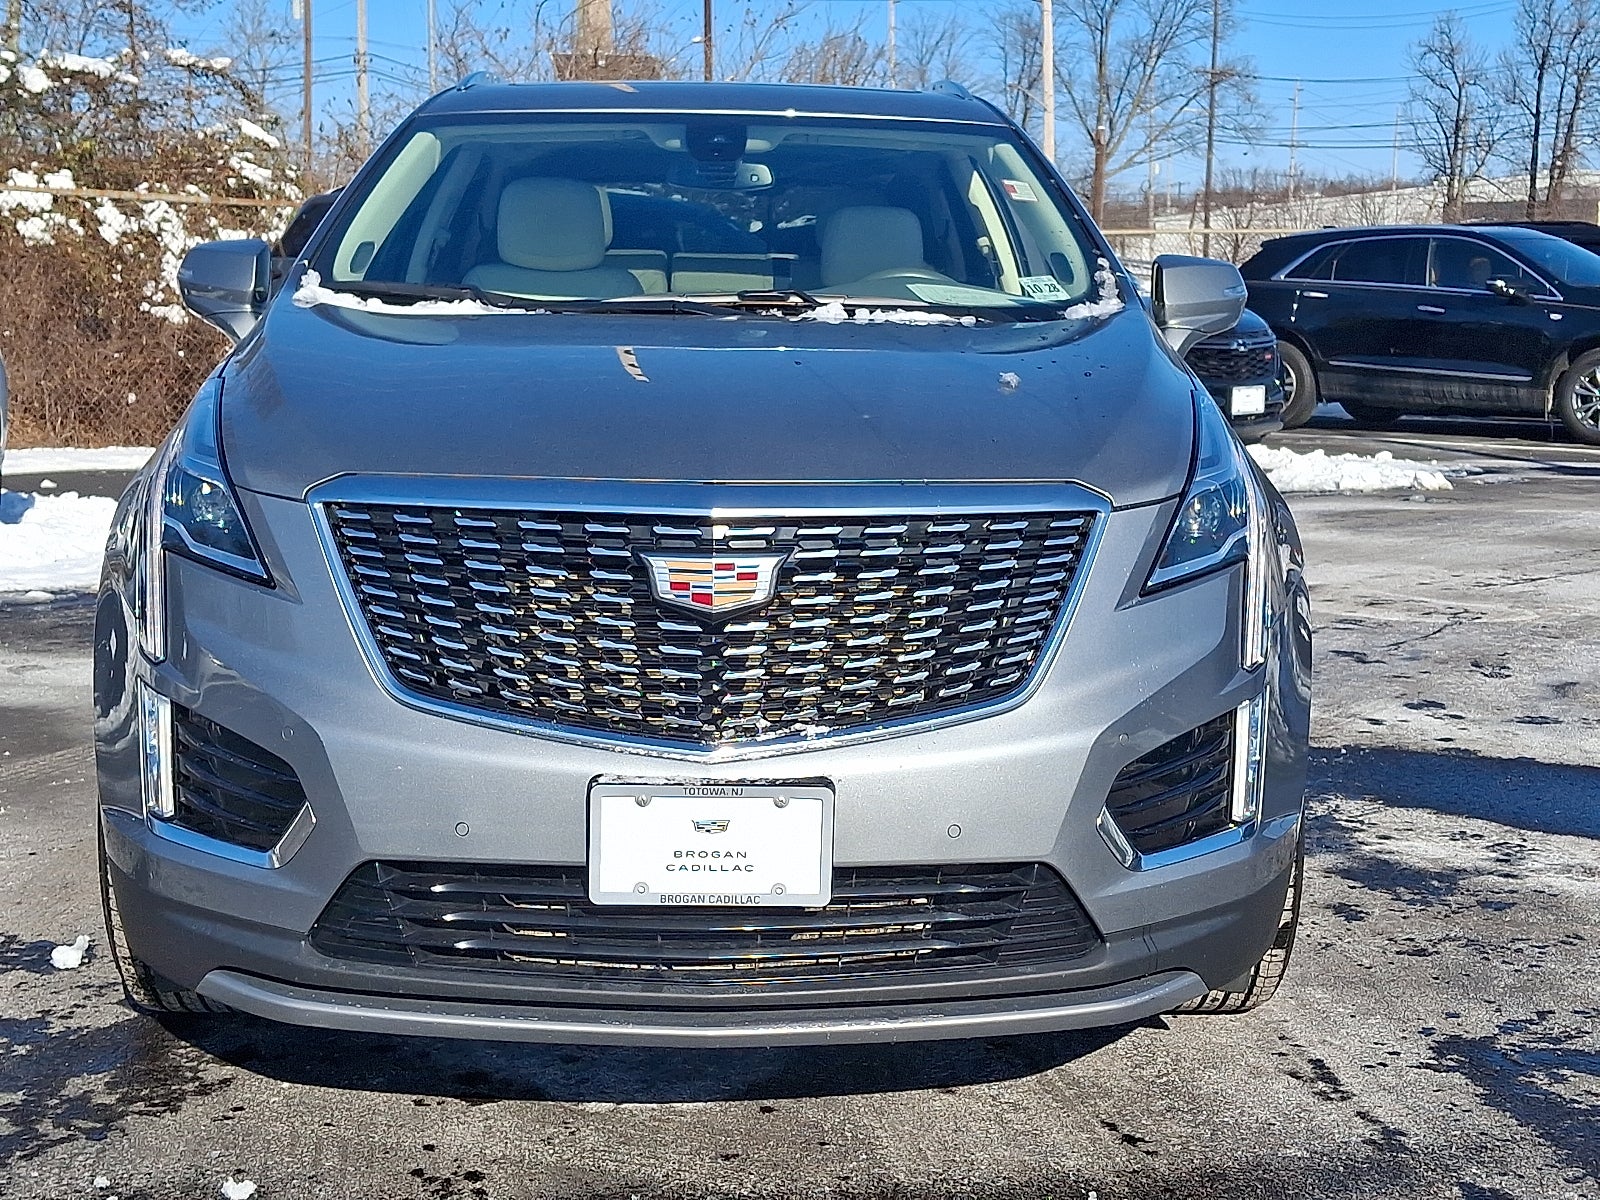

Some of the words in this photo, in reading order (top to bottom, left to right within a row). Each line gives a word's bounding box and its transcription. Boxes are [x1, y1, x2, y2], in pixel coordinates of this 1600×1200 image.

[1027, 284, 1043, 293] 10
[1044, 283, 1060, 293] 28
[731, 787, 744, 796] NJ
[673, 850, 747, 859] BROGAN
[666, 864, 754, 872] CADILLAC
[660, 894, 705, 904] BROGAN
[708, 894, 760, 905] CADILLAC
